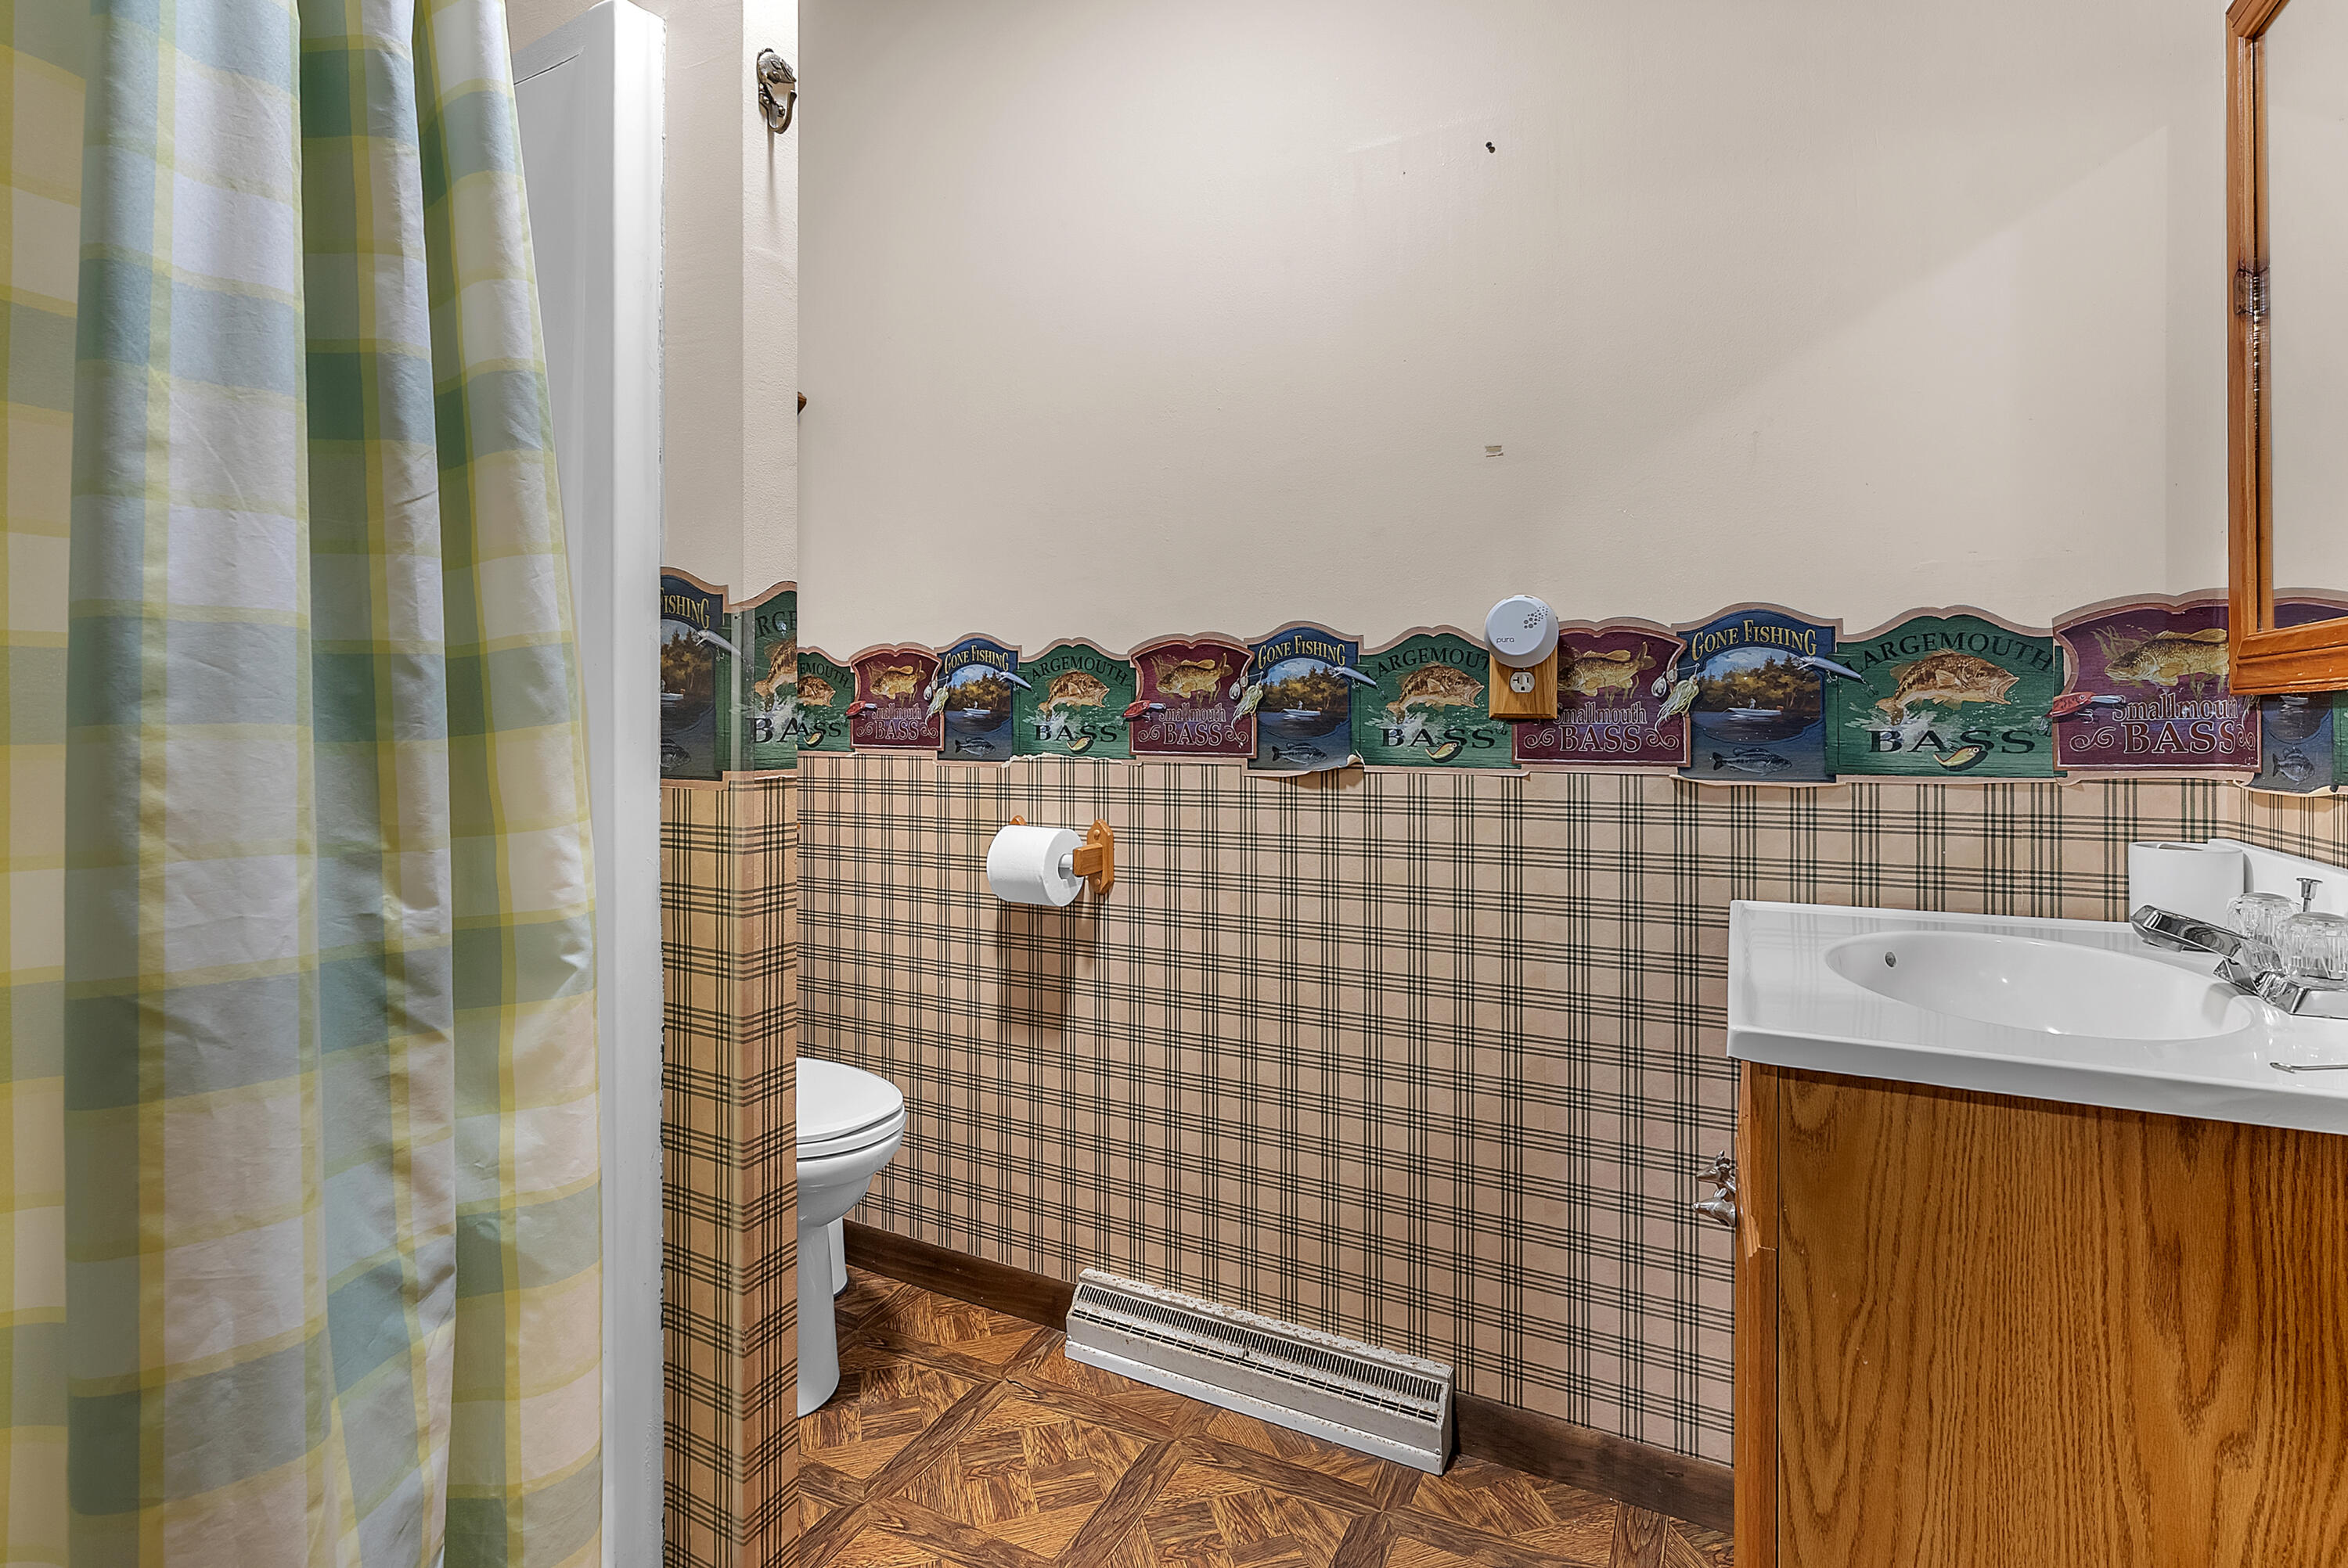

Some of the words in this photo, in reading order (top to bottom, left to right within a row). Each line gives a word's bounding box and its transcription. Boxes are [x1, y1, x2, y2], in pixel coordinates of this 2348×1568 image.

[1259, 642, 1291, 669] GONE
[1294, 635, 1345, 666] FISHING
[1692, 628, 1739, 661] GONE
[1743, 620, 1817, 656] FISHING
[945, 652, 970, 674] GONE
[971, 645, 1009, 671] FISHING
[875, 720, 920, 740] BASS
[1033, 725, 1118, 743] BASS
[1163, 721, 1223, 746] BASS
[1380, 728, 1496, 749] BASS
[1558, 725, 1642, 753] BASS
[1866, 730, 2035, 753] BASS
[2121, 720, 2236, 753] BASS
